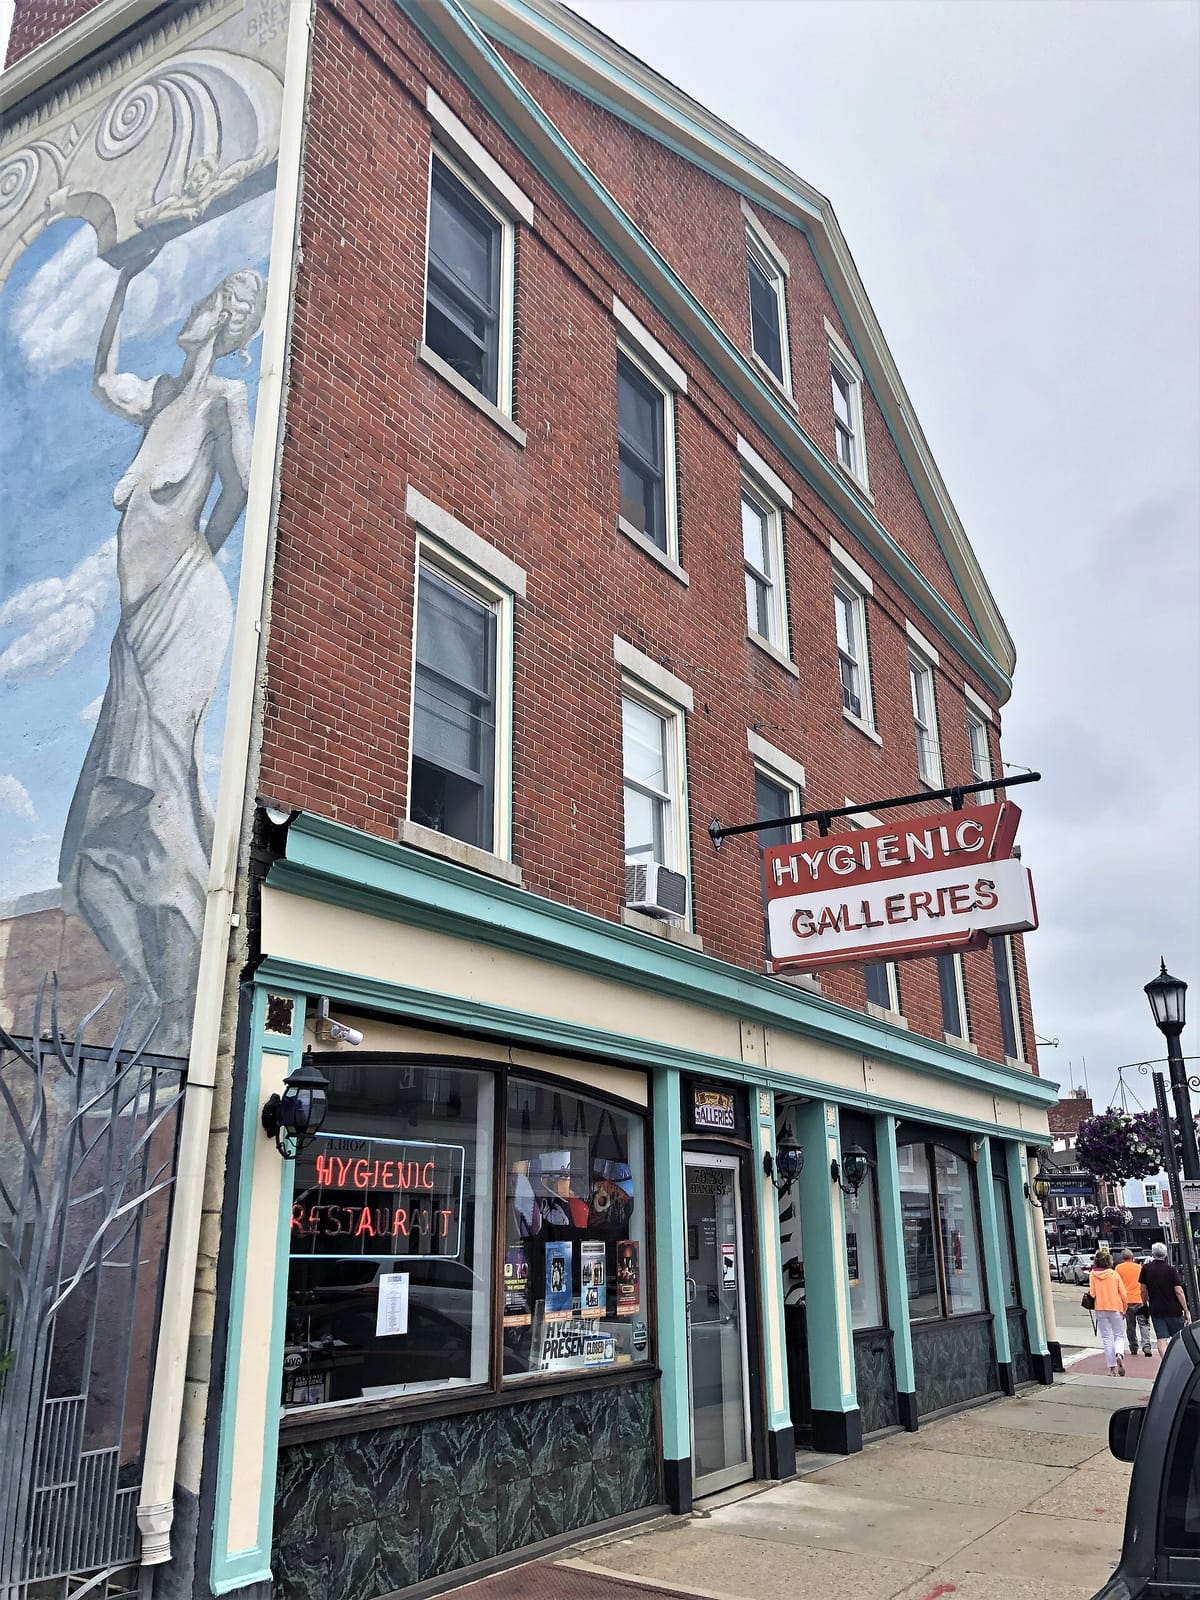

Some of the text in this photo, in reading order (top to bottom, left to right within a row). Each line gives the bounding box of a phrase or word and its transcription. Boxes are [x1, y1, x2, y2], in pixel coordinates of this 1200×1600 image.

[773, 819, 985, 886] HYGIENIC
[791, 878, 999, 939] GALLERIES
[695, 1105, 734, 1127] GALLERIES
[315, 1154, 436, 1189] HYGIENIC
[289, 1203, 452, 1238] RESTAURANT
[586, 1341, 604, 1355] CLOSED
